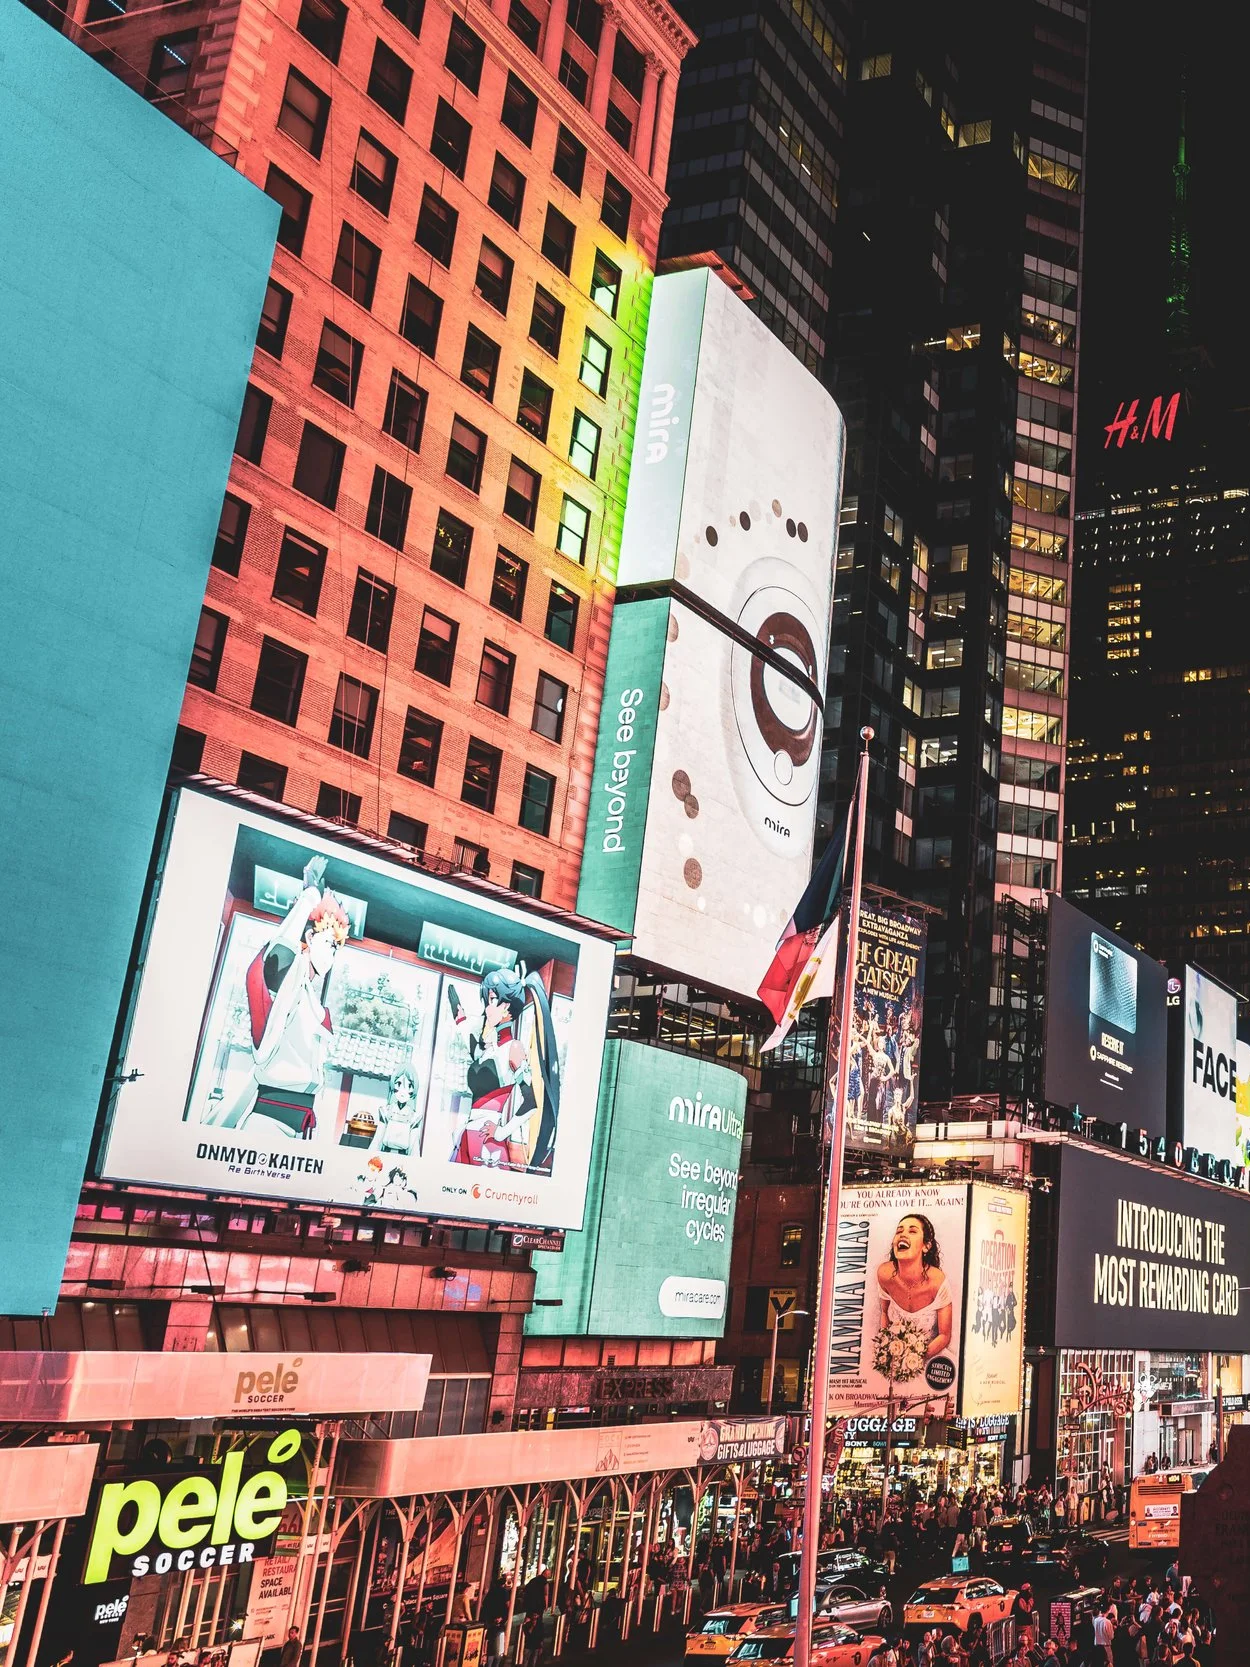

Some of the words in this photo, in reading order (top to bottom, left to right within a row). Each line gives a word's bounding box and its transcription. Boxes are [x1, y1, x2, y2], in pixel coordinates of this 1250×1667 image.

[645, 382, 679, 465] mira
[1104, 392, 1181, 449] H&M
[619, 688, 644, 744] See
[602, 751, 638, 854] beyond
[764, 815, 790, 839] mira
[862, 920, 908, 940] EXTRAVAGANZA
[889, 919, 922, 936] BROADWAY
[874, 946, 919, 978] GREAT
[854, 963, 910, 996] GATSBY
[1166, 996, 1180, 1006] LG
[668, 1091, 721, 1132] mira
[196, 1143, 257, 1166] ONMYO
[268, 1152, 324, 1175] KAITEN
[668, 1152, 700, 1181] See
[442, 1186, 457, 1194] ONLY
[485, 1188, 539, 1205] Crunchyroll
[681, 1184, 731, 1218] irregular
[857, 1190, 874, 1199] YOU
[875, 1189, 913, 1199] ALREADY
[915, 1188, 940, 1198] KNOW
[863, 1199, 893, 1209] GONNA
[895, 1199, 916, 1208] LOVE
[935, 1197, 964, 1207] AGAIN!
[685, 1217, 725, 1245] cycles
[1117, 1198, 1202, 1262] INTRODUCING
[1204, 1220, 1226, 1266] THE
[836, 1221, 871, 1274] MIA!
[980, 1239, 1016, 1270] OPERATION
[1094, 1253, 1136, 1307] MOST
[1139, 1260, 1209, 1314] REWARDING
[1212, 1271, 1239, 1316] CARD
[830, 1280, 866, 1376] MAMMA
[602, 1377, 673, 1399] EXPRESS
[930, 1369, 951, 1377] LIMITED
[248, 1394, 285, 1403] SOCCER
[84, 1428, 302, 1585] pelé
[132, 1543, 255, 1577] SOCCER
[260, 1577, 283, 1588] SPACE
